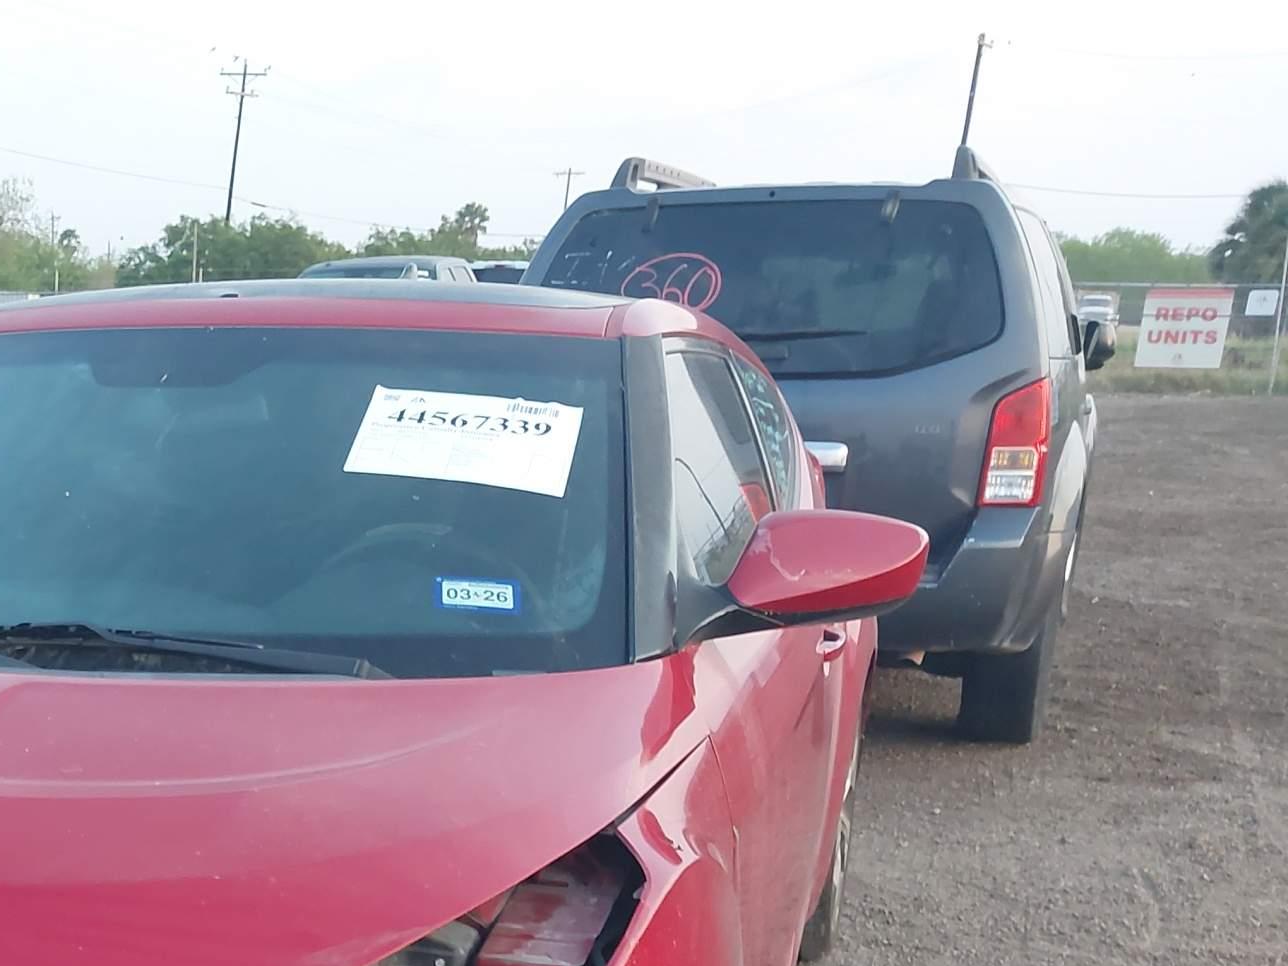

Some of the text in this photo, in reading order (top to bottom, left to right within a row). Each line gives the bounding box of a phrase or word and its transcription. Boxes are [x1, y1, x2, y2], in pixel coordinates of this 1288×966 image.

[1154, 307, 1218, 321] REPO
[1147, 330, 1218, 344] UNITS
[387, 408, 552, 437] 44567339
[446, 588, 509, 603] 03 26
